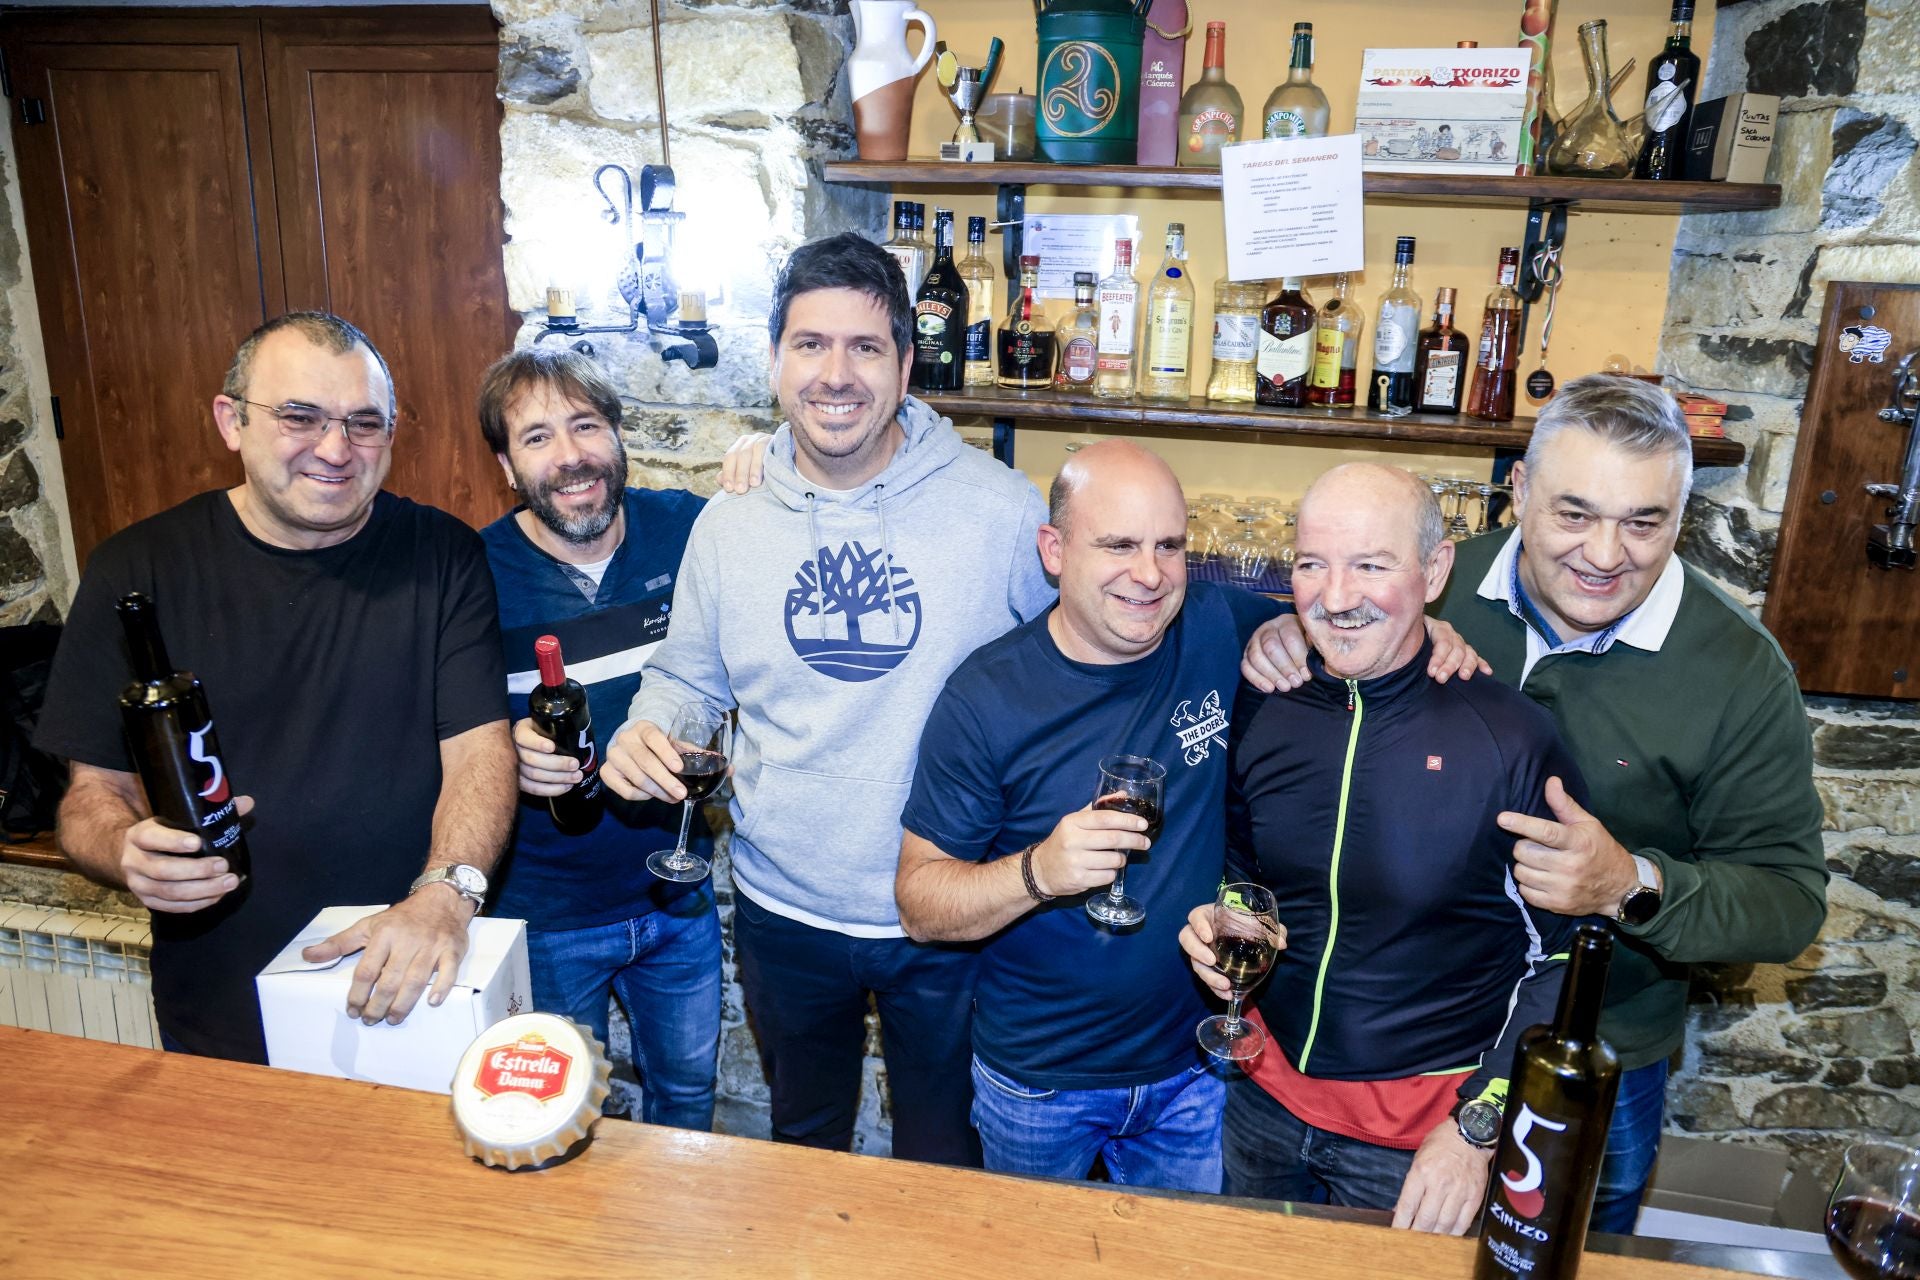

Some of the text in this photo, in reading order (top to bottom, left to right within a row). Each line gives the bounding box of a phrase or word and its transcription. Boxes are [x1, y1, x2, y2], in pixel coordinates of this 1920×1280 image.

[1452, 68, 1520, 78] TXORIZO
[1146, 79, 1176, 88] Cáceres
[1242, 160, 1273, 169] TAREAS
[1292, 153, 1338, 164] SEMANERO
[1102, 292, 1133, 303] BEEFEATER
[1183, 717, 1225, 743] THE DOERS
[491, 1051, 560, 1074] Estrella
[497, 1071, 544, 1089] Damm
[1500, 1102, 1567, 1193] 5
[1488, 1202, 1549, 1242] ZINTZO
